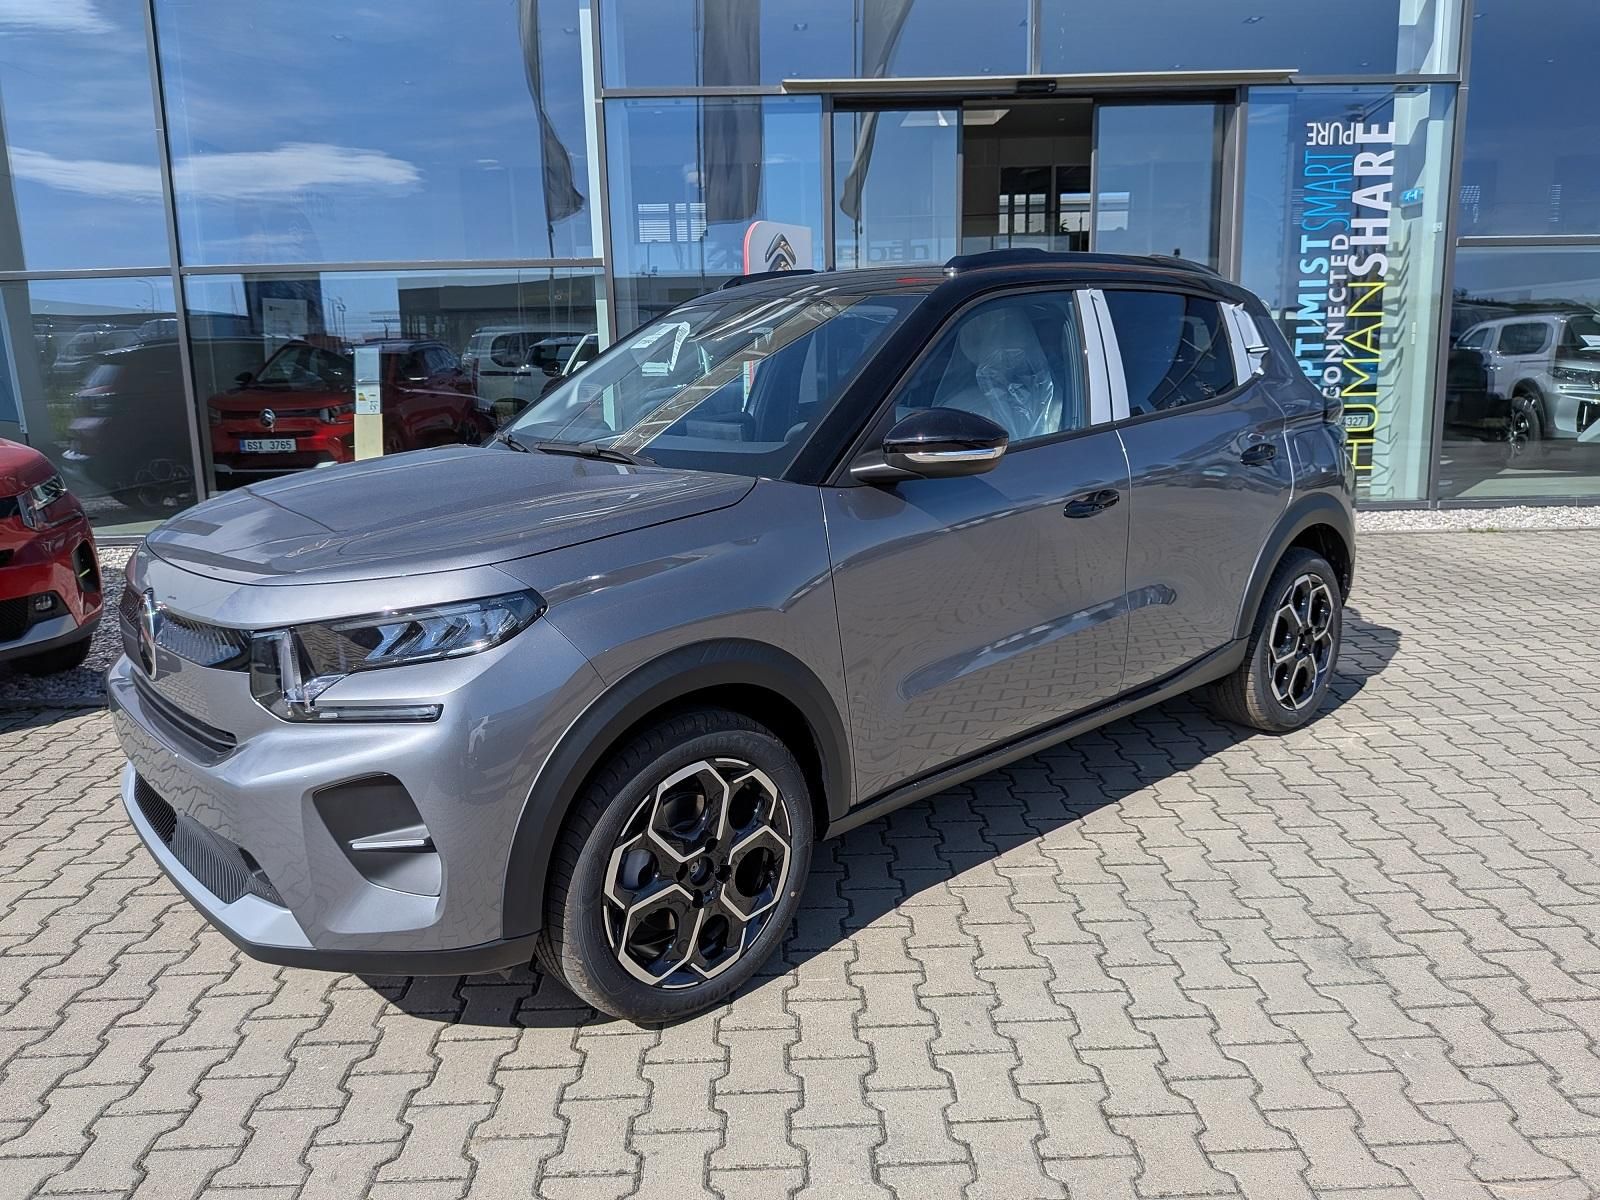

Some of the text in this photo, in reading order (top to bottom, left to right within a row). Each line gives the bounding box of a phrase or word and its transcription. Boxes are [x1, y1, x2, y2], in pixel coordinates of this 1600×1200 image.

[1302, 150, 1353, 231] SMART
[1306, 121, 1354, 146] PURE
[1348, 121, 1396, 277] SHARE
[1295, 235, 1330, 391] PTIMIST
[1323, 234, 1349, 398] CONNECTED
[1340, 282, 1387, 470] HUMAN
[270, 440, 292, 450] 3765
